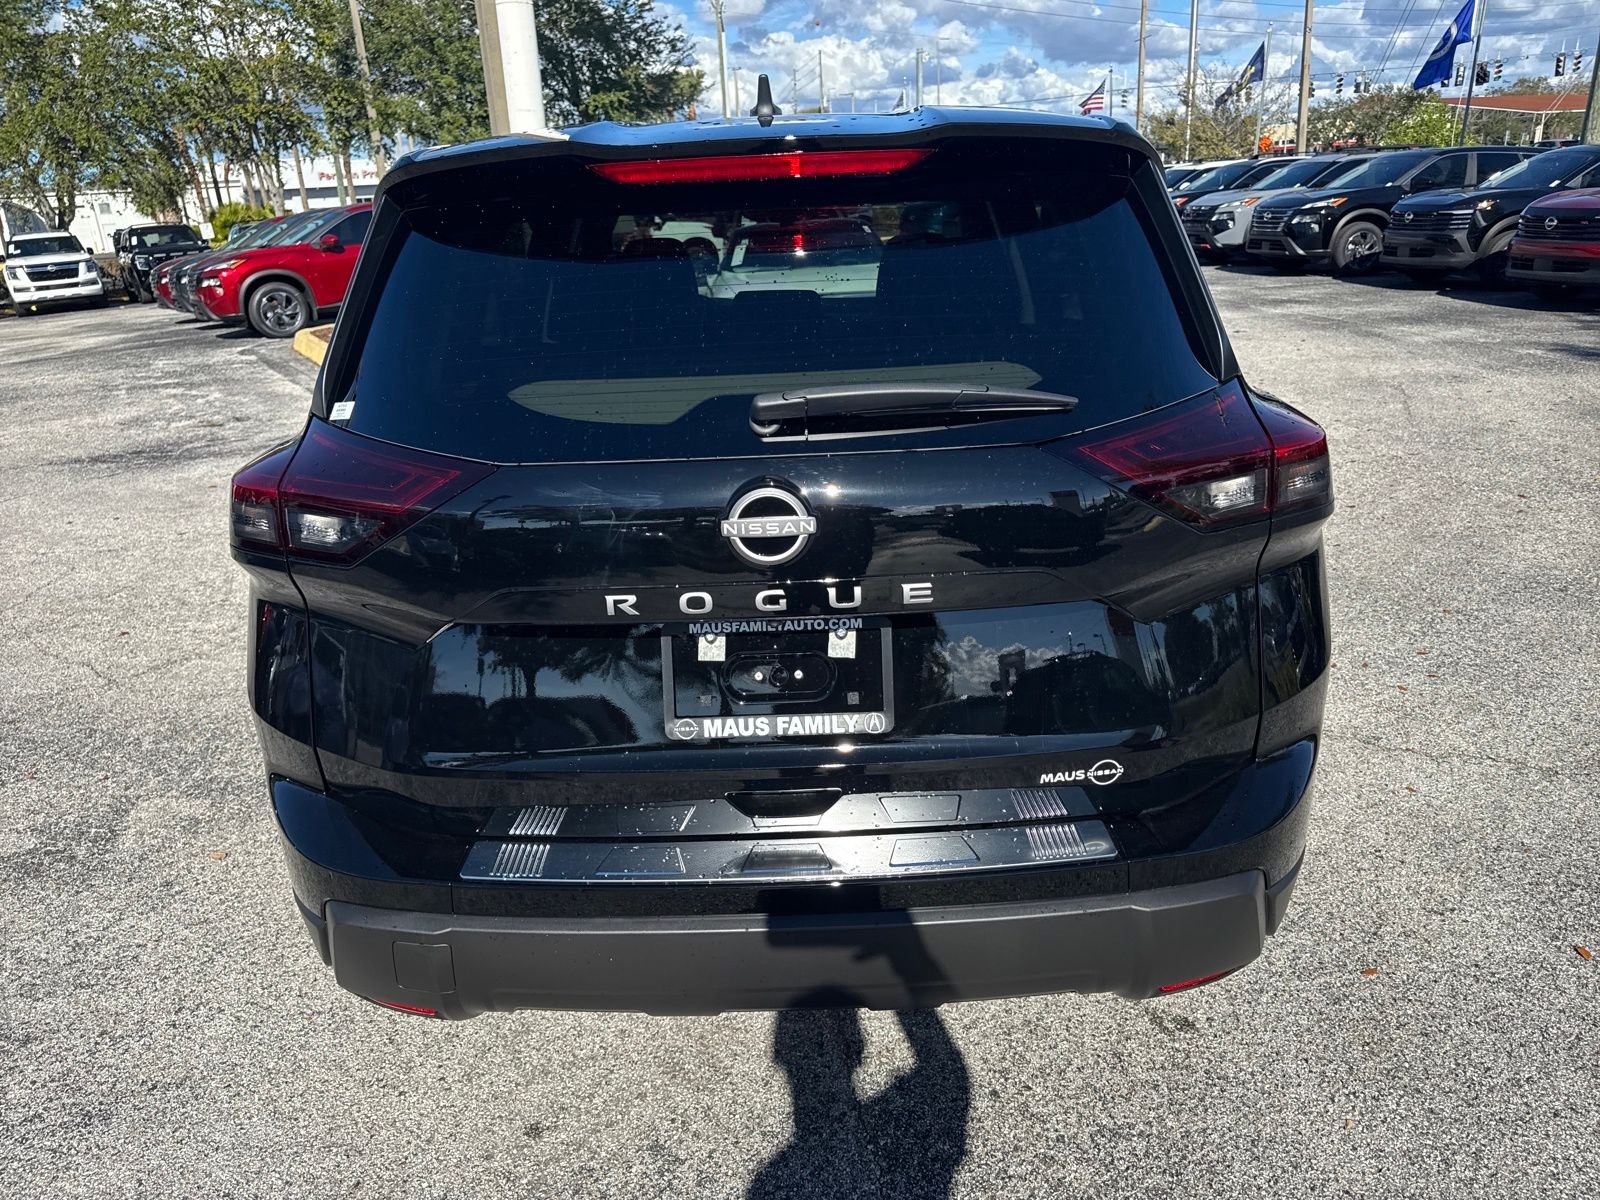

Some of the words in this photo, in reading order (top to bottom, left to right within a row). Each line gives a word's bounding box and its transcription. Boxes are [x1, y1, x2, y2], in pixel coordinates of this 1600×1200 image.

[723, 520, 814, 535] NISSAN
[605, 582, 934, 616] ROGUE
[703, 717, 770, 738] MAUS
[776, 714, 859, 735] FAMILY
[1040, 770, 1085, 784] MAUS
[1087, 767, 1124, 777] NISSAN
